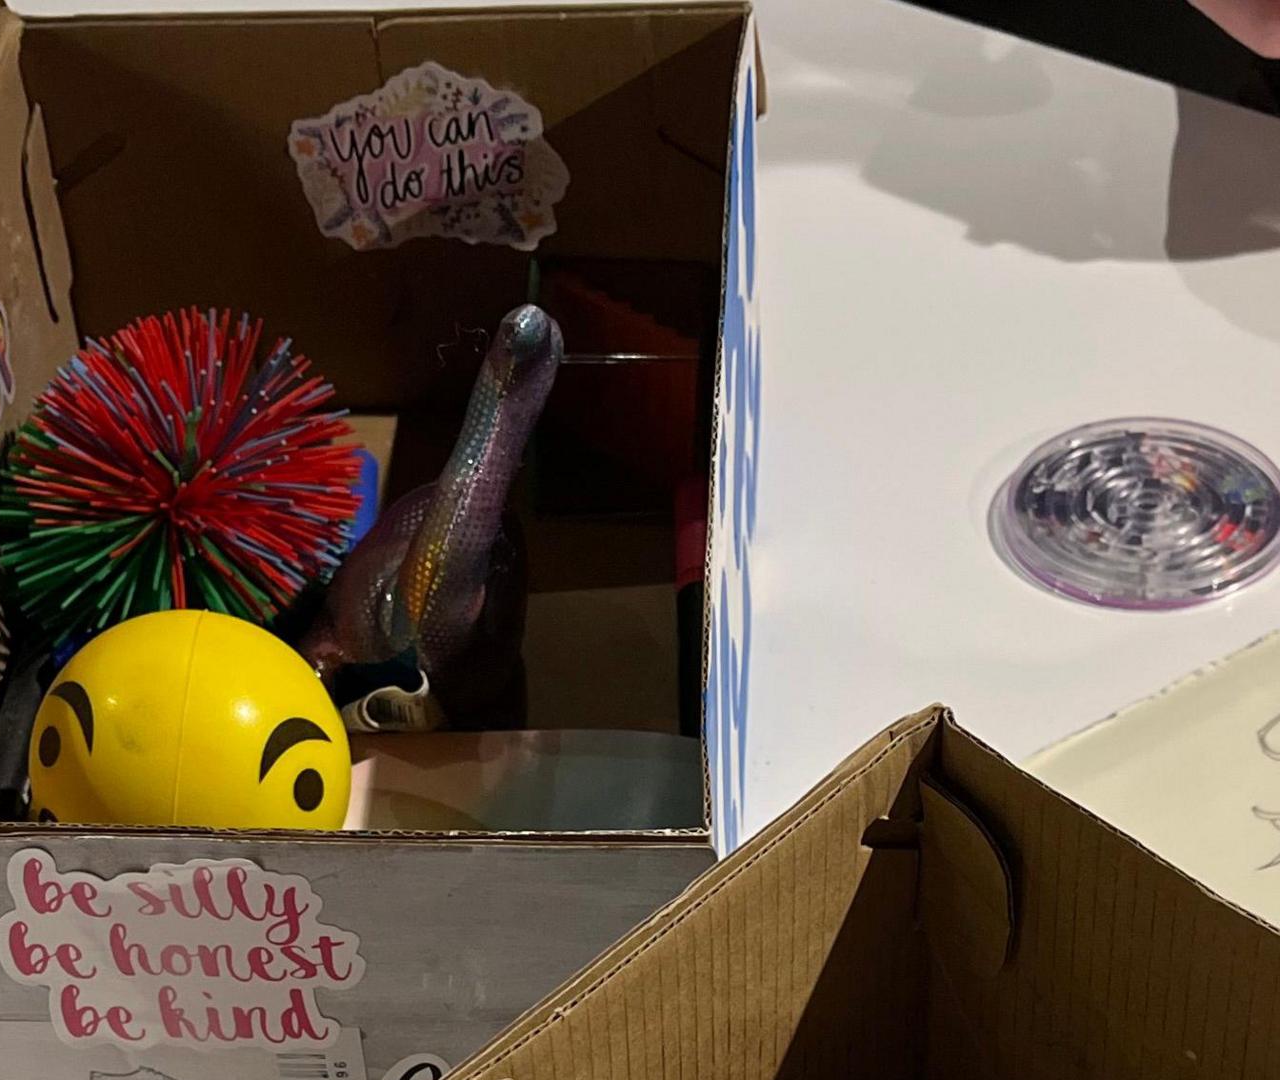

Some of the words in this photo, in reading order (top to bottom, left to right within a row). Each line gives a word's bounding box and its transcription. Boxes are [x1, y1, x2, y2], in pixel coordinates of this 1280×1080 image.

[330, 119, 412, 203] you
[429, 110, 494, 148] can
[380, 161, 424, 209] do
[442, 149, 524, 198] this
[22, 858, 111, 917] be
[128, 867, 309, 944] silly
[8, 922, 96, 977] be
[110, 923, 352, 981] honest
[60, 985, 145, 1039] be
[158, 986, 328, 1043] kind
